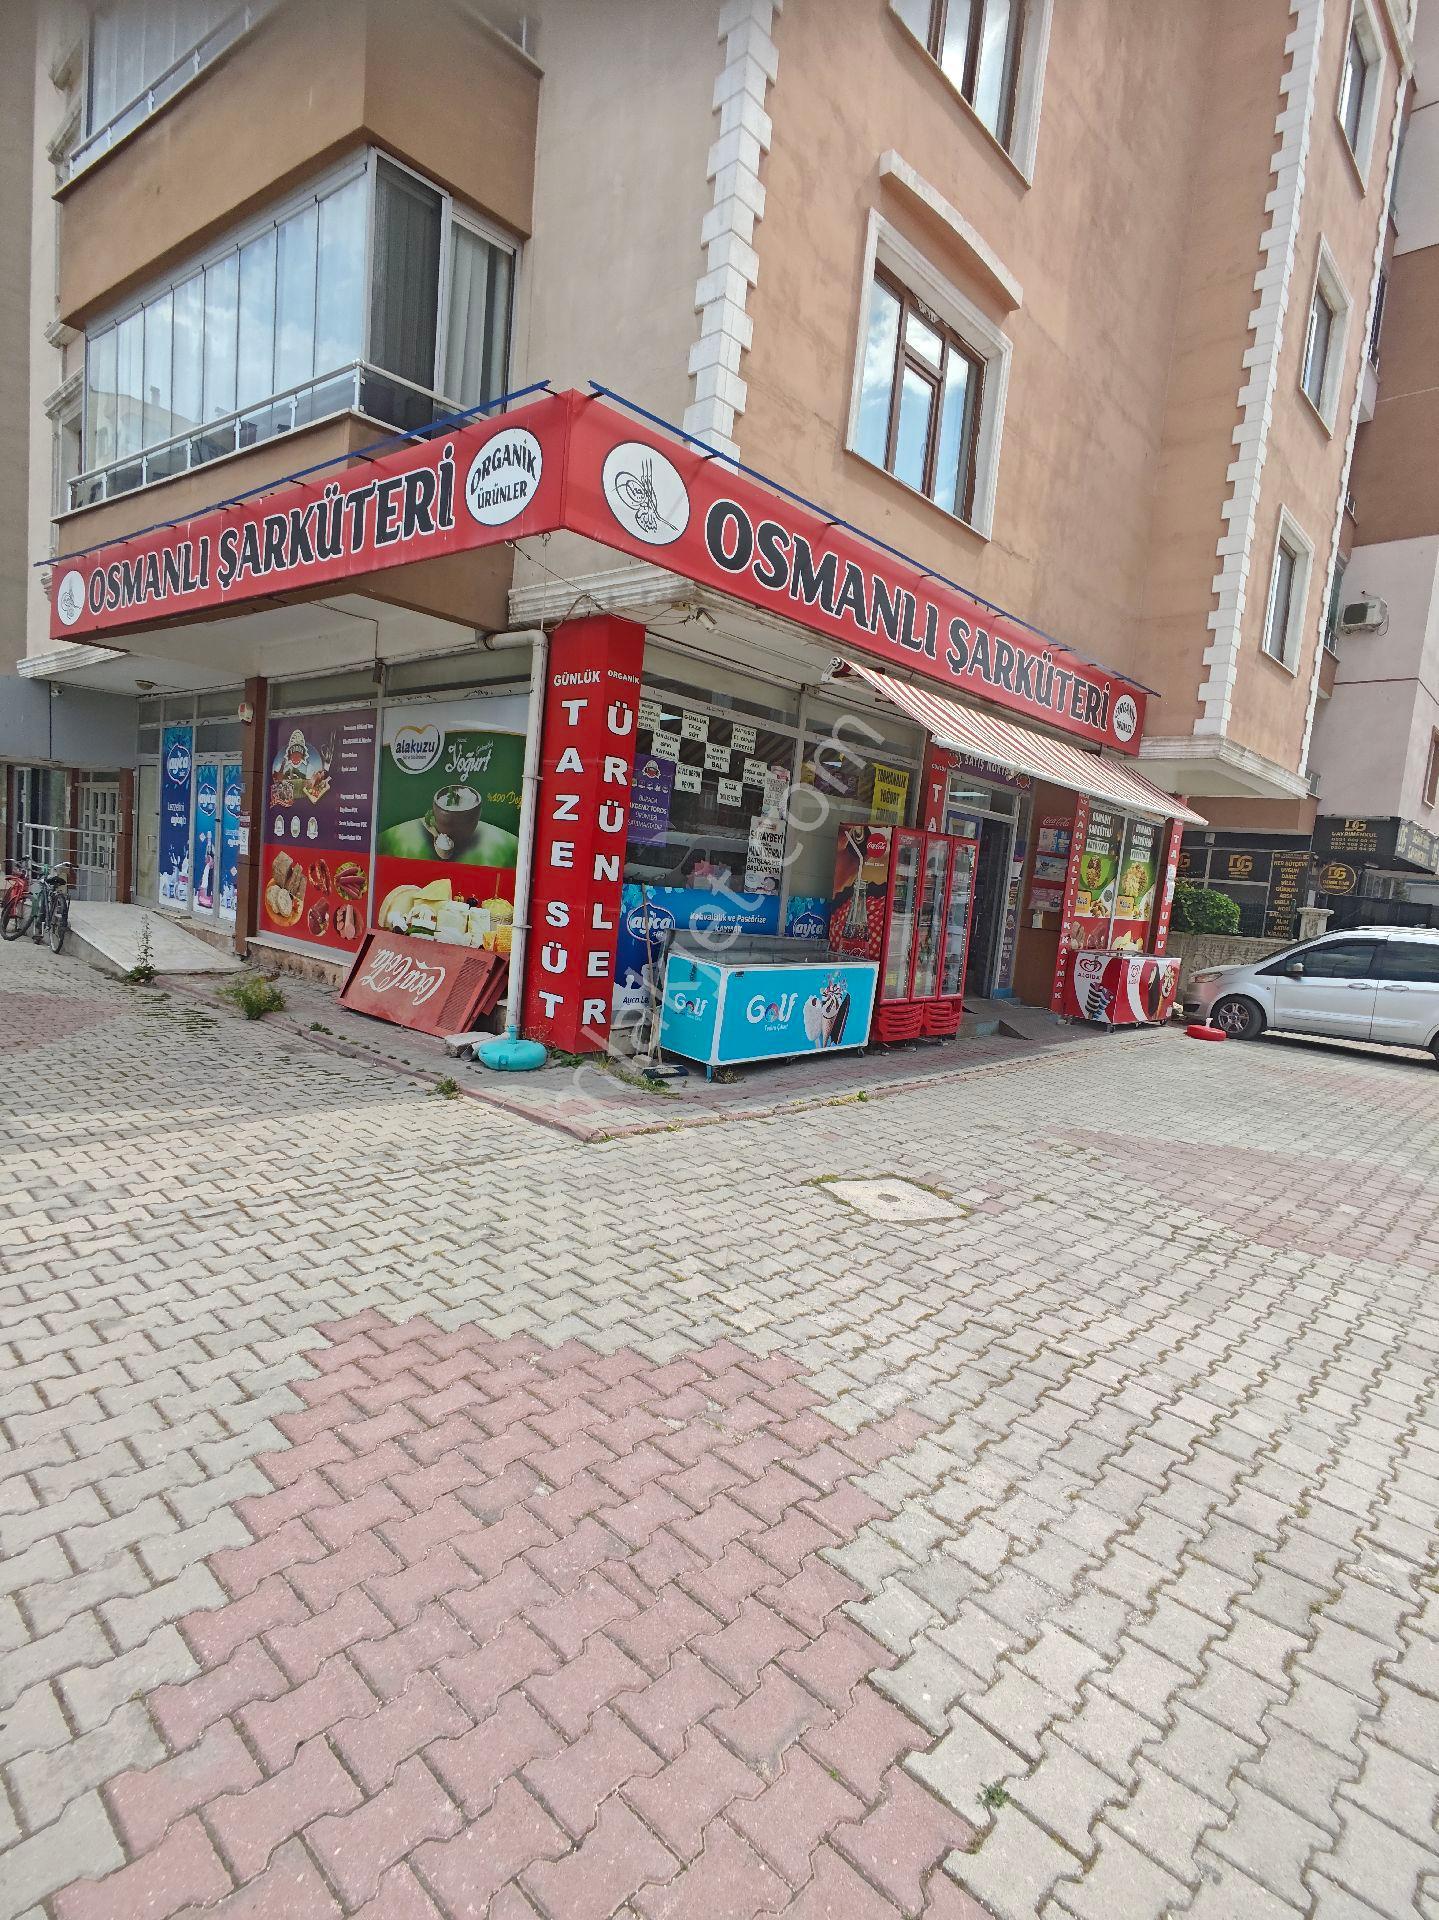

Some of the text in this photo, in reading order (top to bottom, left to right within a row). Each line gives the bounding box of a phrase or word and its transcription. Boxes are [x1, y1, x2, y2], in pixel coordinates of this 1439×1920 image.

[469, 438, 536, 495] ORGANİK
[477, 482, 528, 510] ÜRÜNLER
[88, 442, 456, 616] OSMANLI ŞARKÜTERİ
[705, 498, 1111, 732] OSMANLI ŞARKÜTERİ
[553, 670, 600, 687] GÜNLÜK
[607, 669, 641, 685] ORGANİK
[395, 738, 436, 754] alakuzu
[445, 743, 492, 782] Yoğurt
[711, 761, 723, 770] BAL
[581, 700, 634, 1025] ÜRÜNLER
[673, 992, 709, 1017] Golf
[746, 992, 799, 1024] Golf
